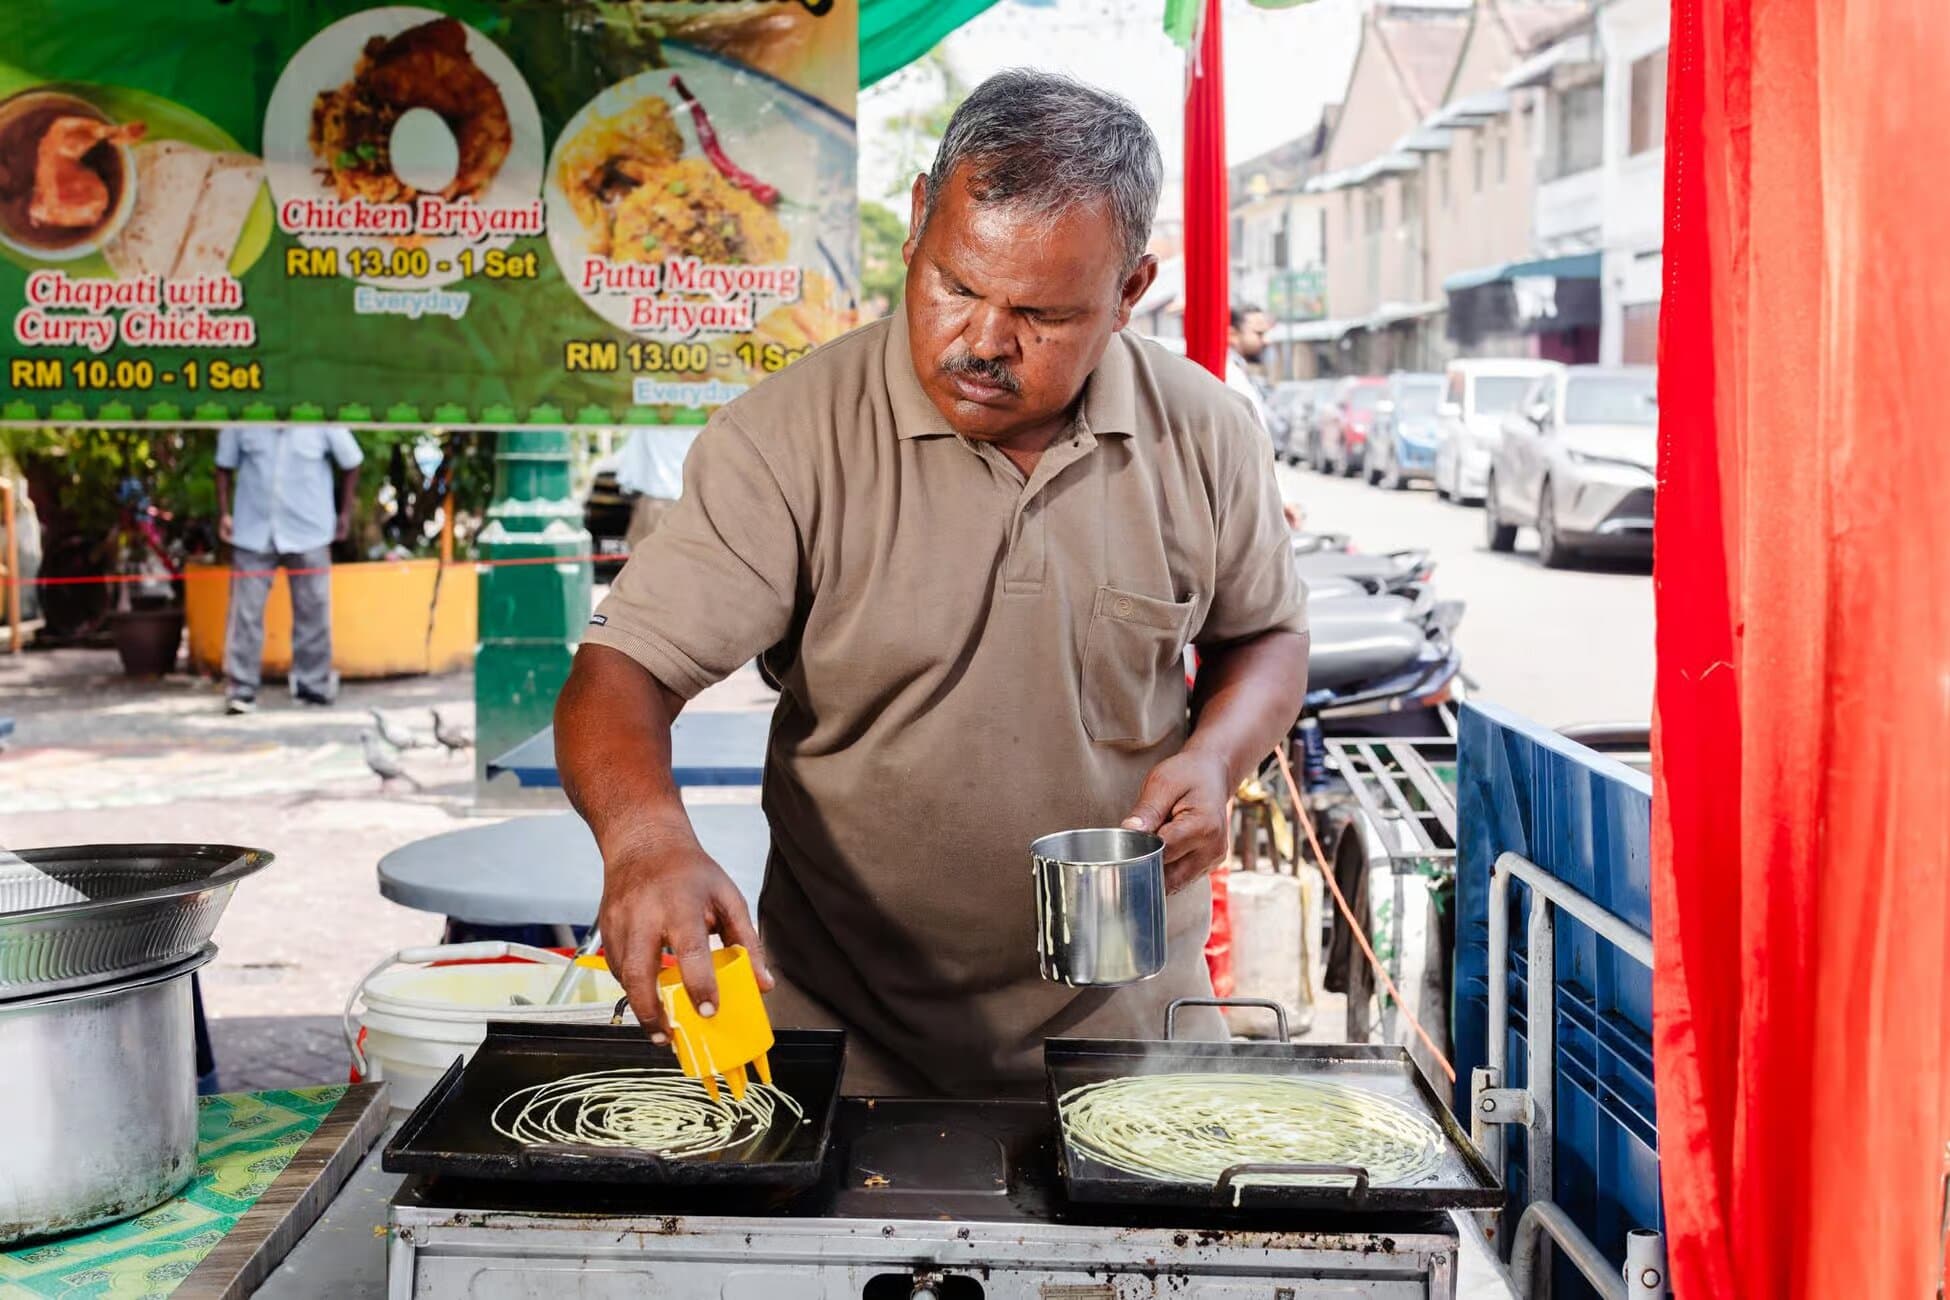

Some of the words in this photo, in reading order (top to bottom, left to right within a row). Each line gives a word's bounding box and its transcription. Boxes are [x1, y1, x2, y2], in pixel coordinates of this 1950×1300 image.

[282, 199, 409, 230] Chicken
[419, 200, 542, 237] Briyani
[285, 247, 338, 277] RM
[346, 248, 430, 278] 13.00
[457, 249, 475, 277] 1
[483, 249, 539, 279] Set
[582, 260, 656, 290] Putu
[666, 261, 797, 300] Mayong
[30, 274, 157, 312] Chapati
[163, 275, 240, 304] with
[356, 287, 468, 316] Everyday
[18, 313, 114, 350] Curry
[123, 313, 255, 342] Chicken
[630, 296, 751, 332] Briyani
[10, 358, 64, 388] RM
[71, 360, 154, 390] 10.00
[182, 361, 198, 388] 1
[208, 361, 262, 390] Set
[564, 343, 619, 372] RM
[626, 343, 709, 373] 13.00
[736, 343, 754, 370] 1
